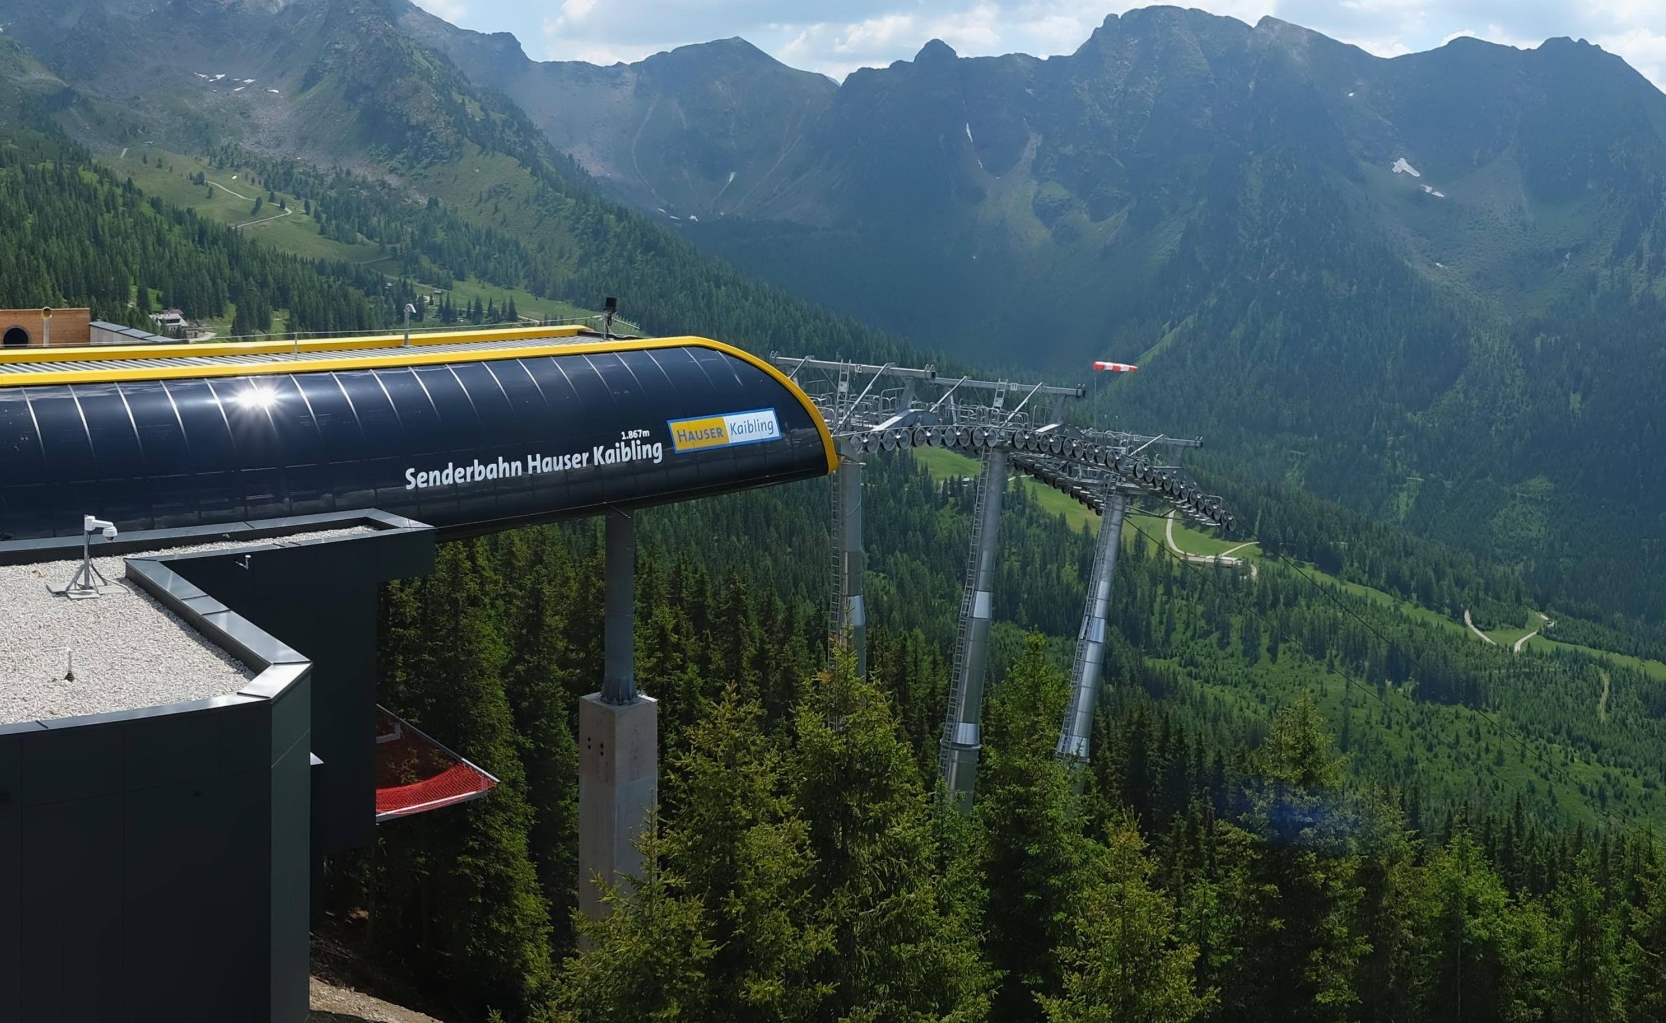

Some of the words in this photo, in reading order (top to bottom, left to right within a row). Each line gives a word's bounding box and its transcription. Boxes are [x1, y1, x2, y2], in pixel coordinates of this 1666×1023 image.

[620, 429, 650, 441] 1.867m
[677, 427, 724, 443] HAUSER
[729, 418, 774, 436] Kaibling
[405, 455, 522, 491] Senderbahn
[526, 450, 590, 475] Hauser
[593, 440, 663, 466] Kaibling
